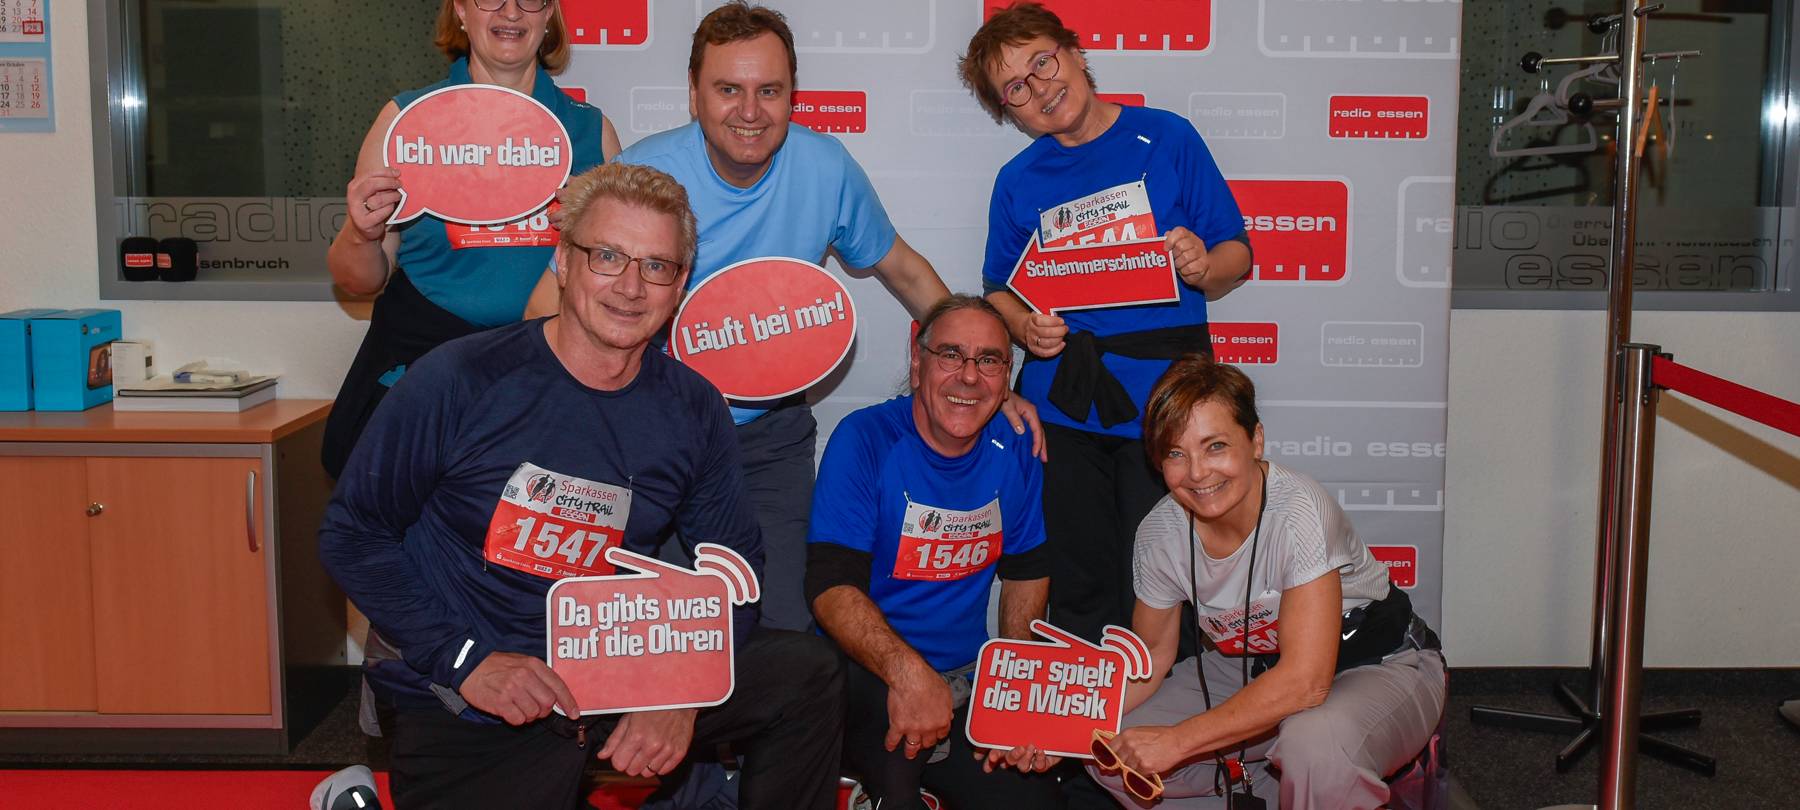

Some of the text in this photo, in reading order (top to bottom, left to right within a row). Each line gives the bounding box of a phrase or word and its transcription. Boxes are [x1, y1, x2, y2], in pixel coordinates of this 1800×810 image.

[1, 92, 10, 100] 17
[31, 92, 40, 100] 19
[31, 101, 41, 109] 26
[820, 105, 862, 113] essen
[1333, 108, 1424, 119] radio essen
[395, 135, 561, 167] Ich war dabei
[1074, 190, 1128, 212] Sparkassen
[1026, 250, 1168, 277] Schlemmerschnitte
[681, 291, 845, 355] Läuft bei mir!
[1231, 335, 1274, 344] essen
[1327, 335, 1366, 346] radio
[1264, 436, 1446, 457] radio esse
[560, 480, 618, 502] Sparkassen
[946, 510, 992, 523] Sparkassen
[513, 516, 609, 568] 1547
[916, 541, 989, 570] 1546
[558, 592, 721, 631] Da gibts was
[557, 623, 724, 660] auf die Ohren
[989, 648, 1117, 691] Hier spielt
[983, 680, 1107, 720] die Musik
